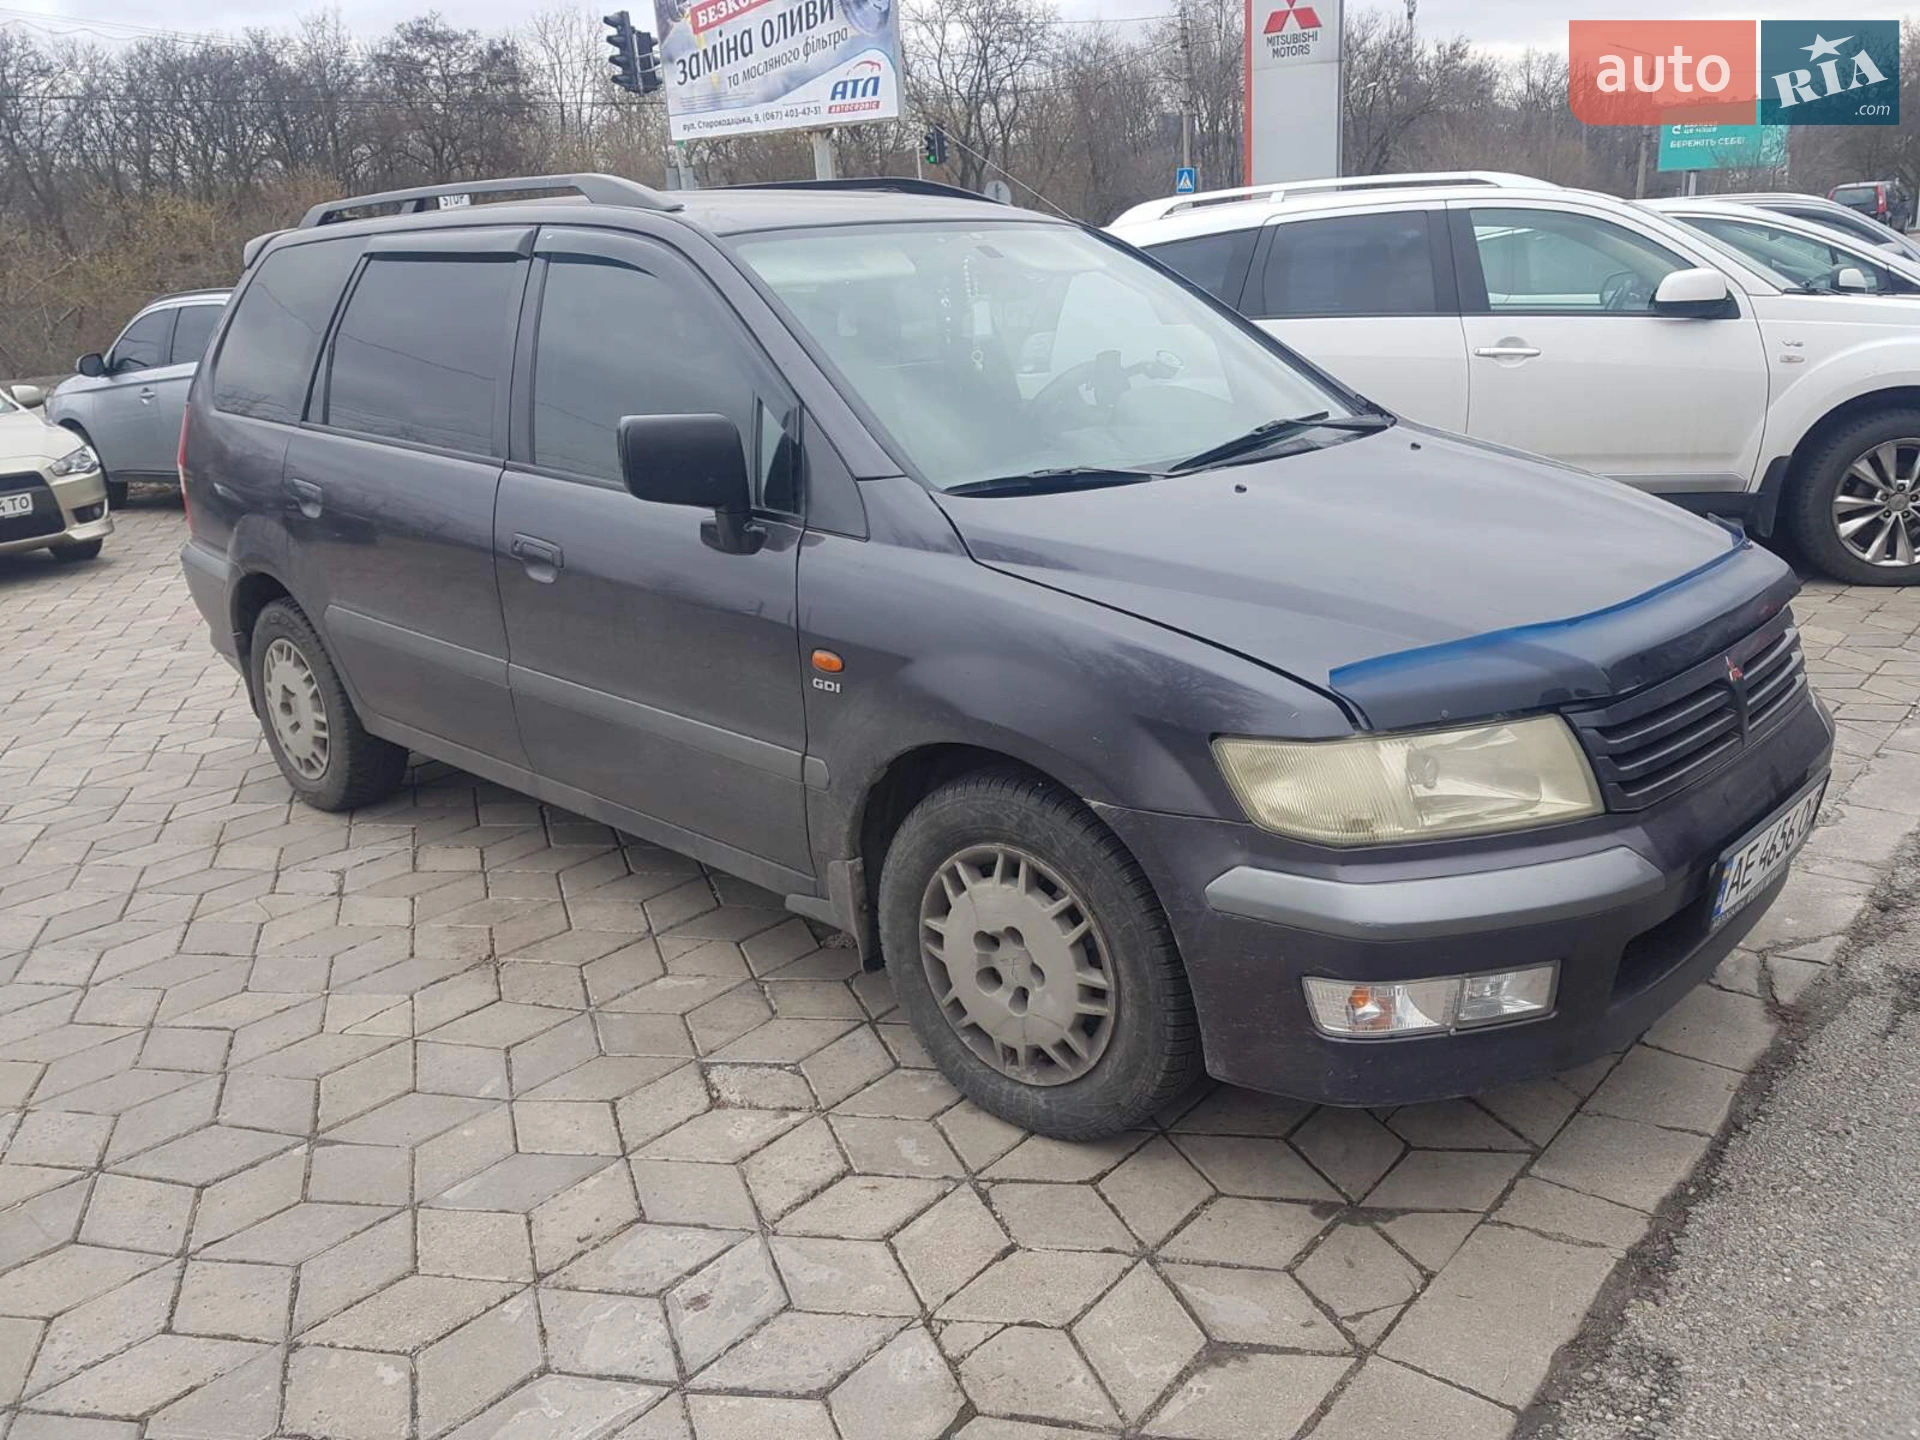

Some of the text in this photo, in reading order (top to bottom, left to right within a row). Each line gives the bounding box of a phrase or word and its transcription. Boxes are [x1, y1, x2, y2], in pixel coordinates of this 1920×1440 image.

[1267, 31, 1318, 46] MITSUBISHI
[727, 27, 848, 88] та масляного фільтра
[1272, 45, 1310, 58] MOTORS
[7, 496, 29, 511] TO
[812, 677, 840, 693] GDI
[1725, 842, 1759, 903] AE
[1759, 808, 1799, 871] 4656
